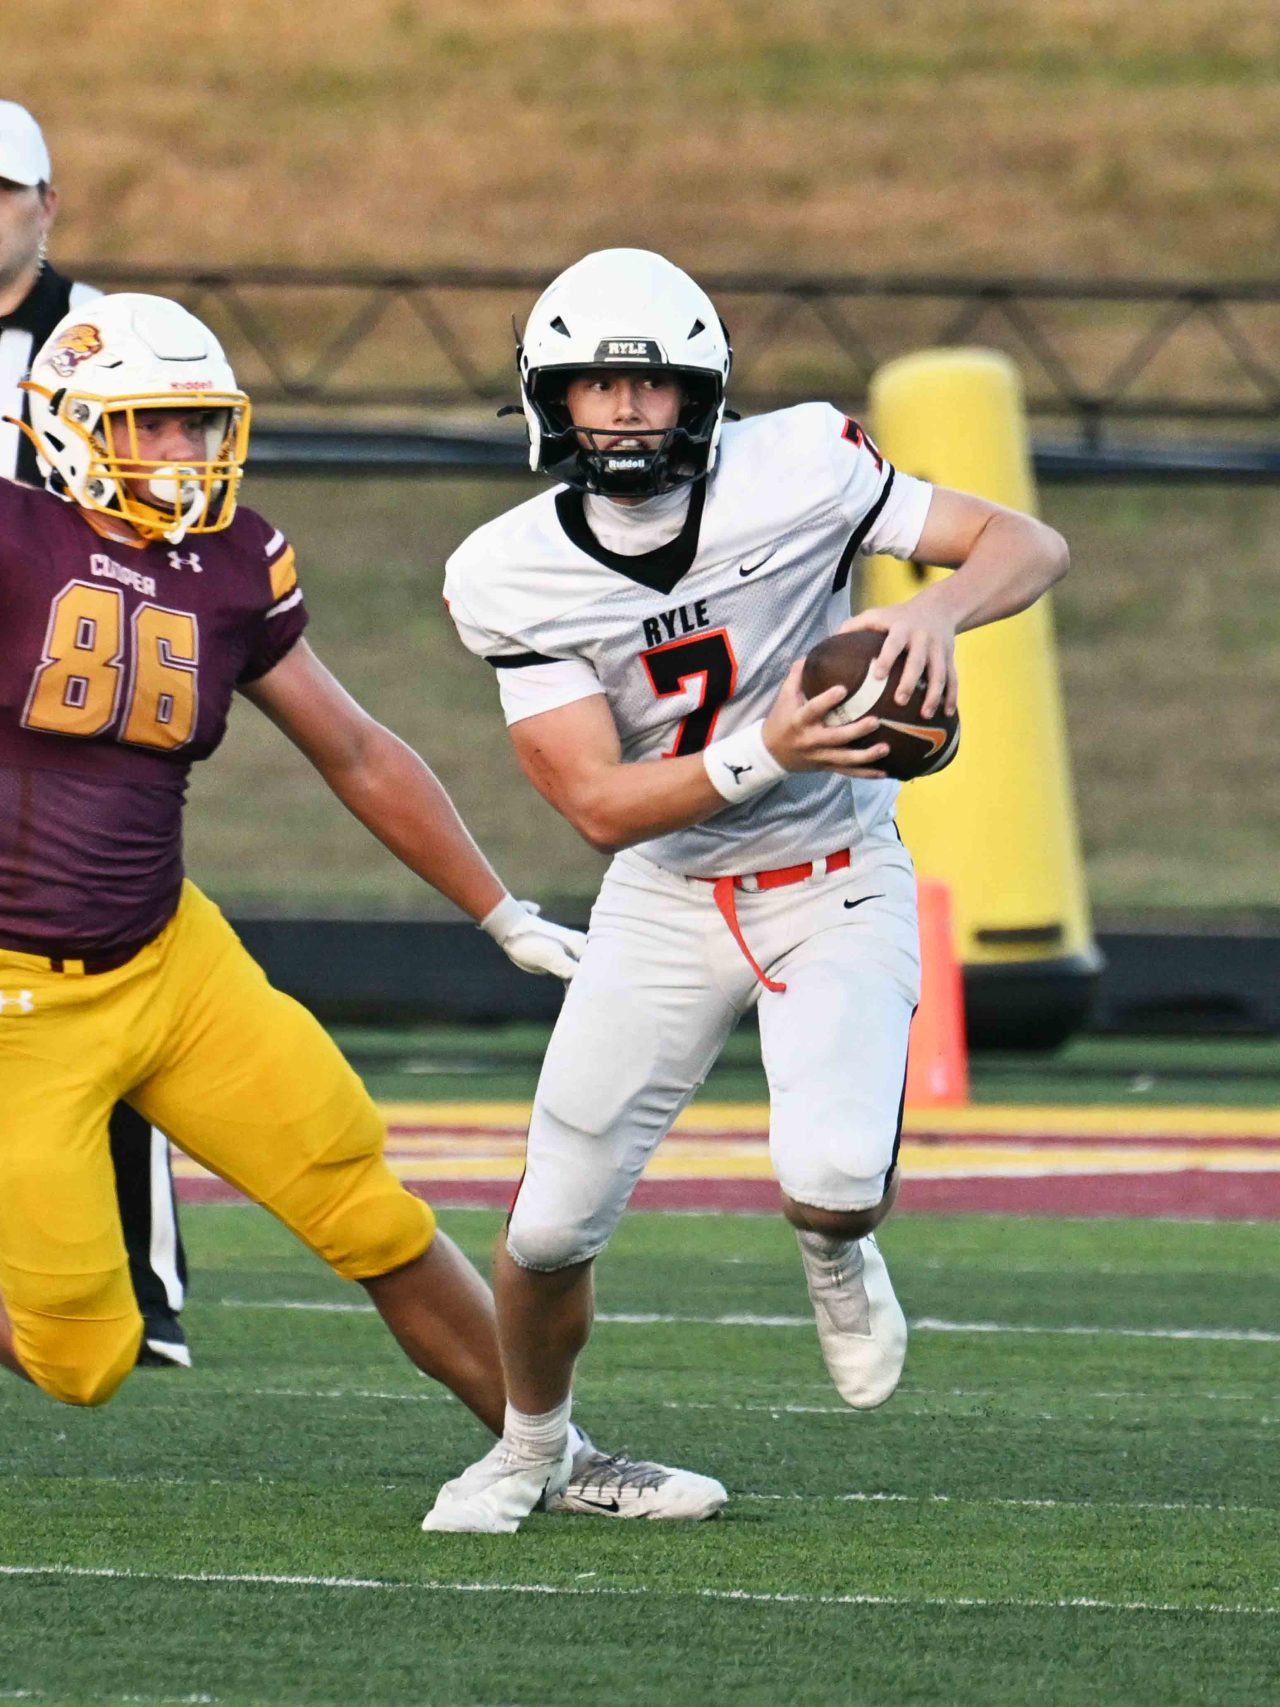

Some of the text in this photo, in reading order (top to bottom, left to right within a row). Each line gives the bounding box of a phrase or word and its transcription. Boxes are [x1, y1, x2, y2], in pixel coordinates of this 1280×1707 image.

[608, 342, 647, 354] RYLE
[608, 459, 645, 470] Riddell
[642, 599, 710, 647] RYLE
[21, 579, 200, 752] 86
[640, 626, 738, 759] 7
